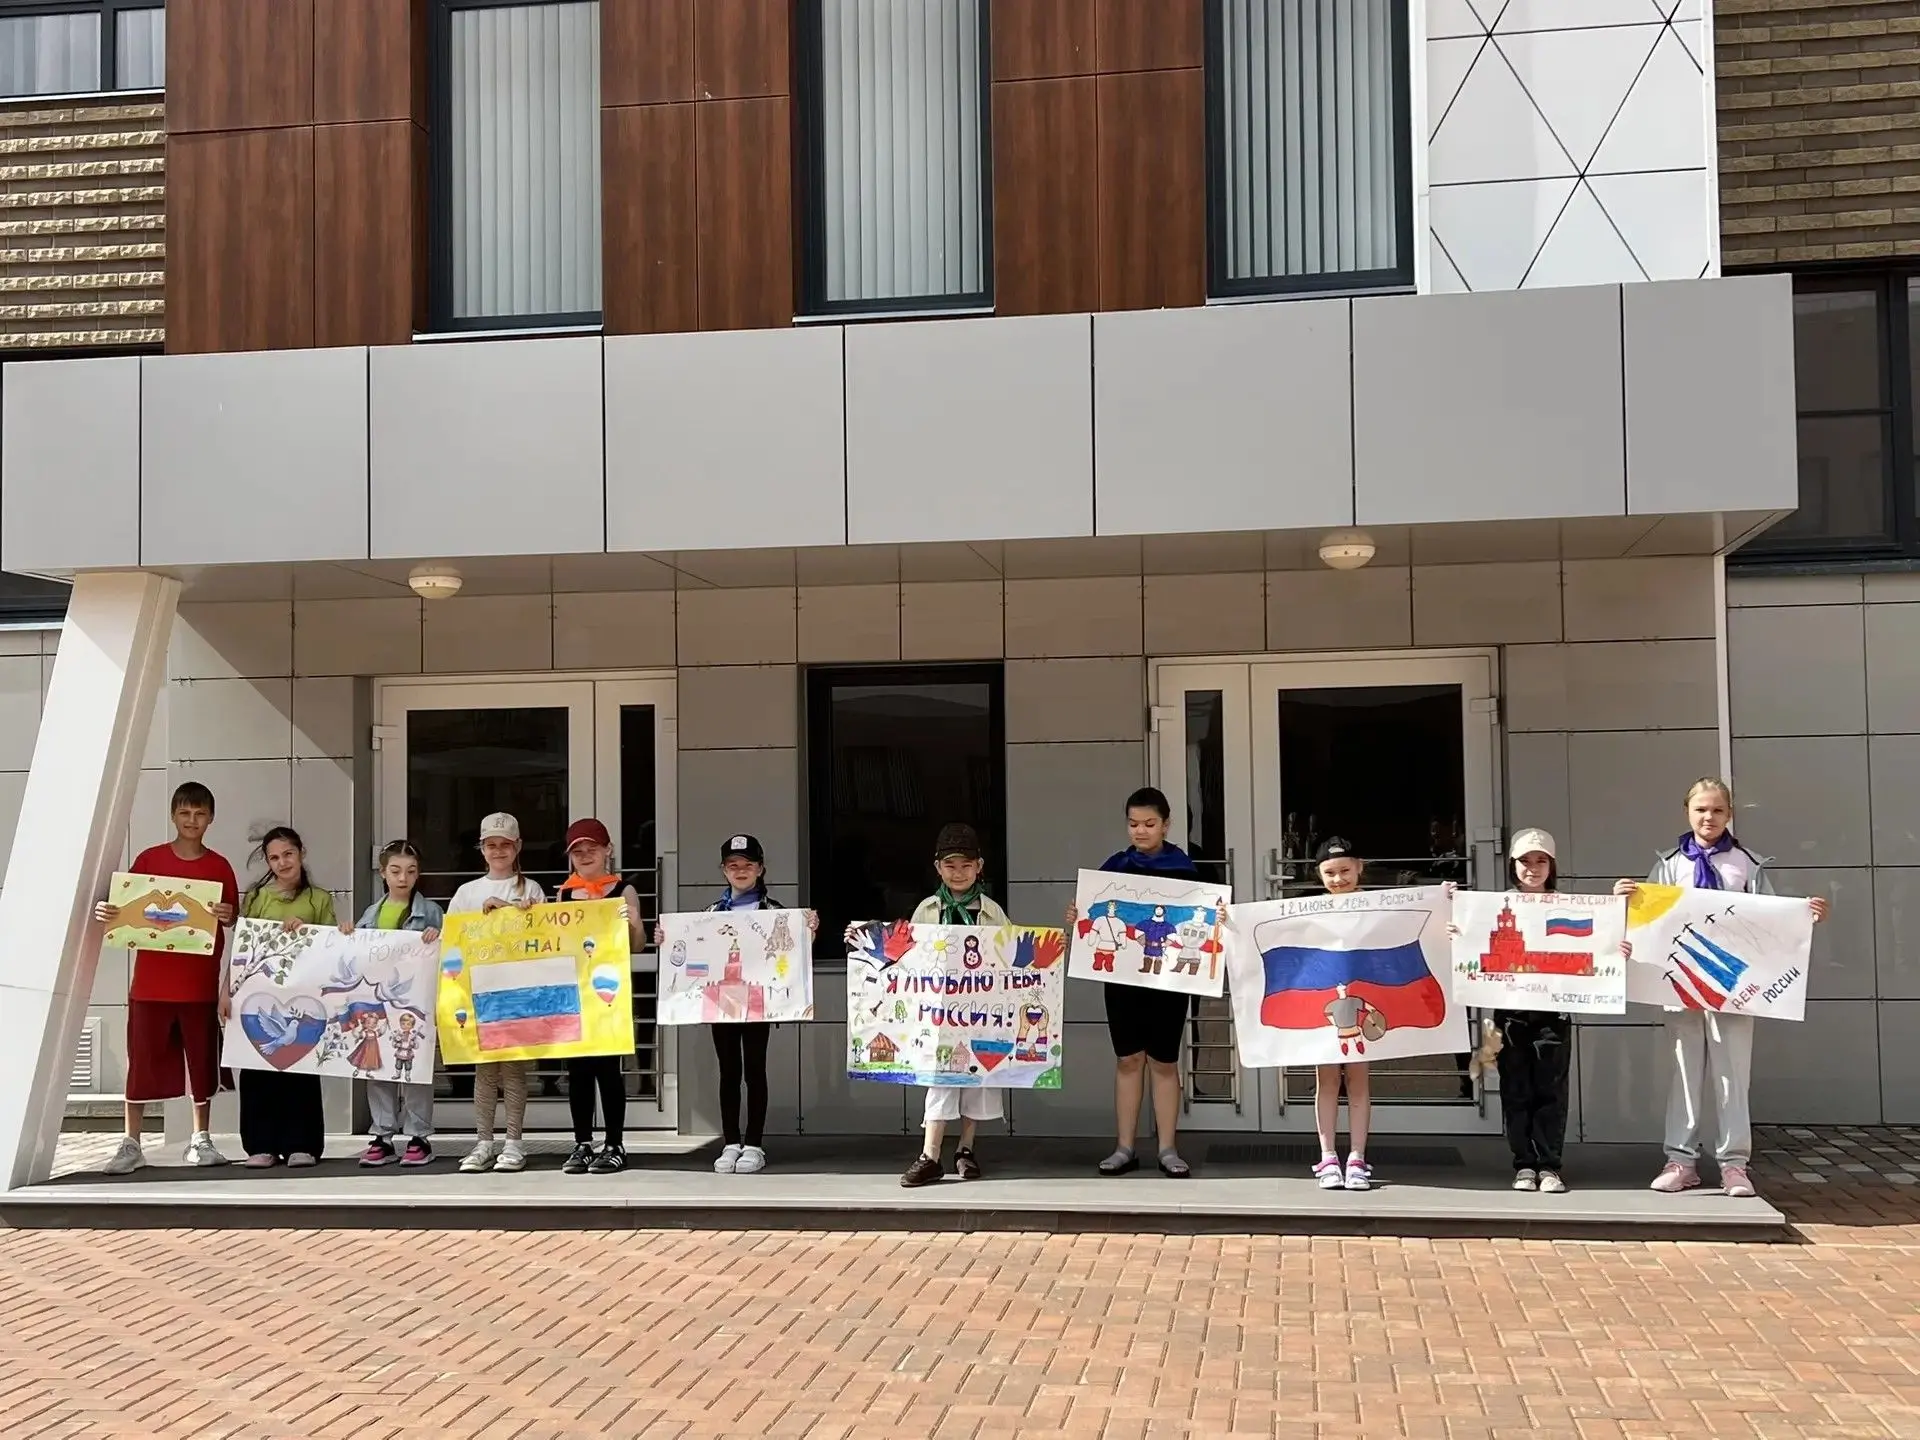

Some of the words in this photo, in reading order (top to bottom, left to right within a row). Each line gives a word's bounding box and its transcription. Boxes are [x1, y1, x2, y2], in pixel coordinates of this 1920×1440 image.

[539, 909, 585, 928] МОЯ
[1279, 901, 1296, 916] 12
[1299, 899, 1335, 914] ИЮНЯ
[885, 968, 899, 994] Я
[904, 967, 995, 995] ЛЮБЛЮ
[1000, 969, 1046, 990] ТЕБЯ,
[1761, 966, 1801, 1004] РОССИИ
[1731, 983, 1761, 1010] ДЕНЬ
[918, 1000, 1016, 1028] РОССИЯ!
